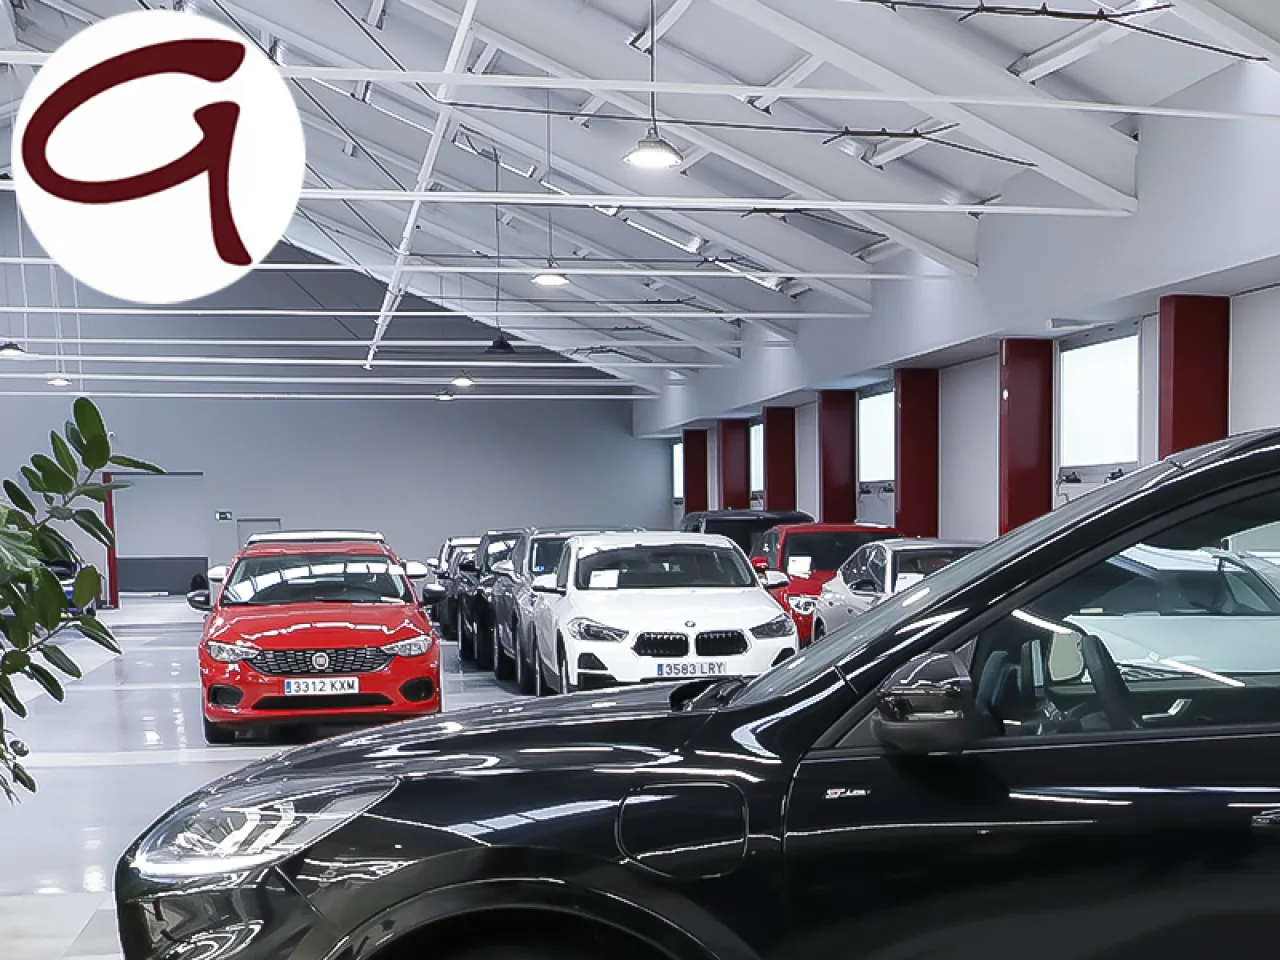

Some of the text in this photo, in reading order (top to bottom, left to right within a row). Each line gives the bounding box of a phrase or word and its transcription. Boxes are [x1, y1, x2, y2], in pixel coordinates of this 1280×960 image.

[665, 662, 724, 676] 3583 LRY
[294, 680, 326, 693] 3312
